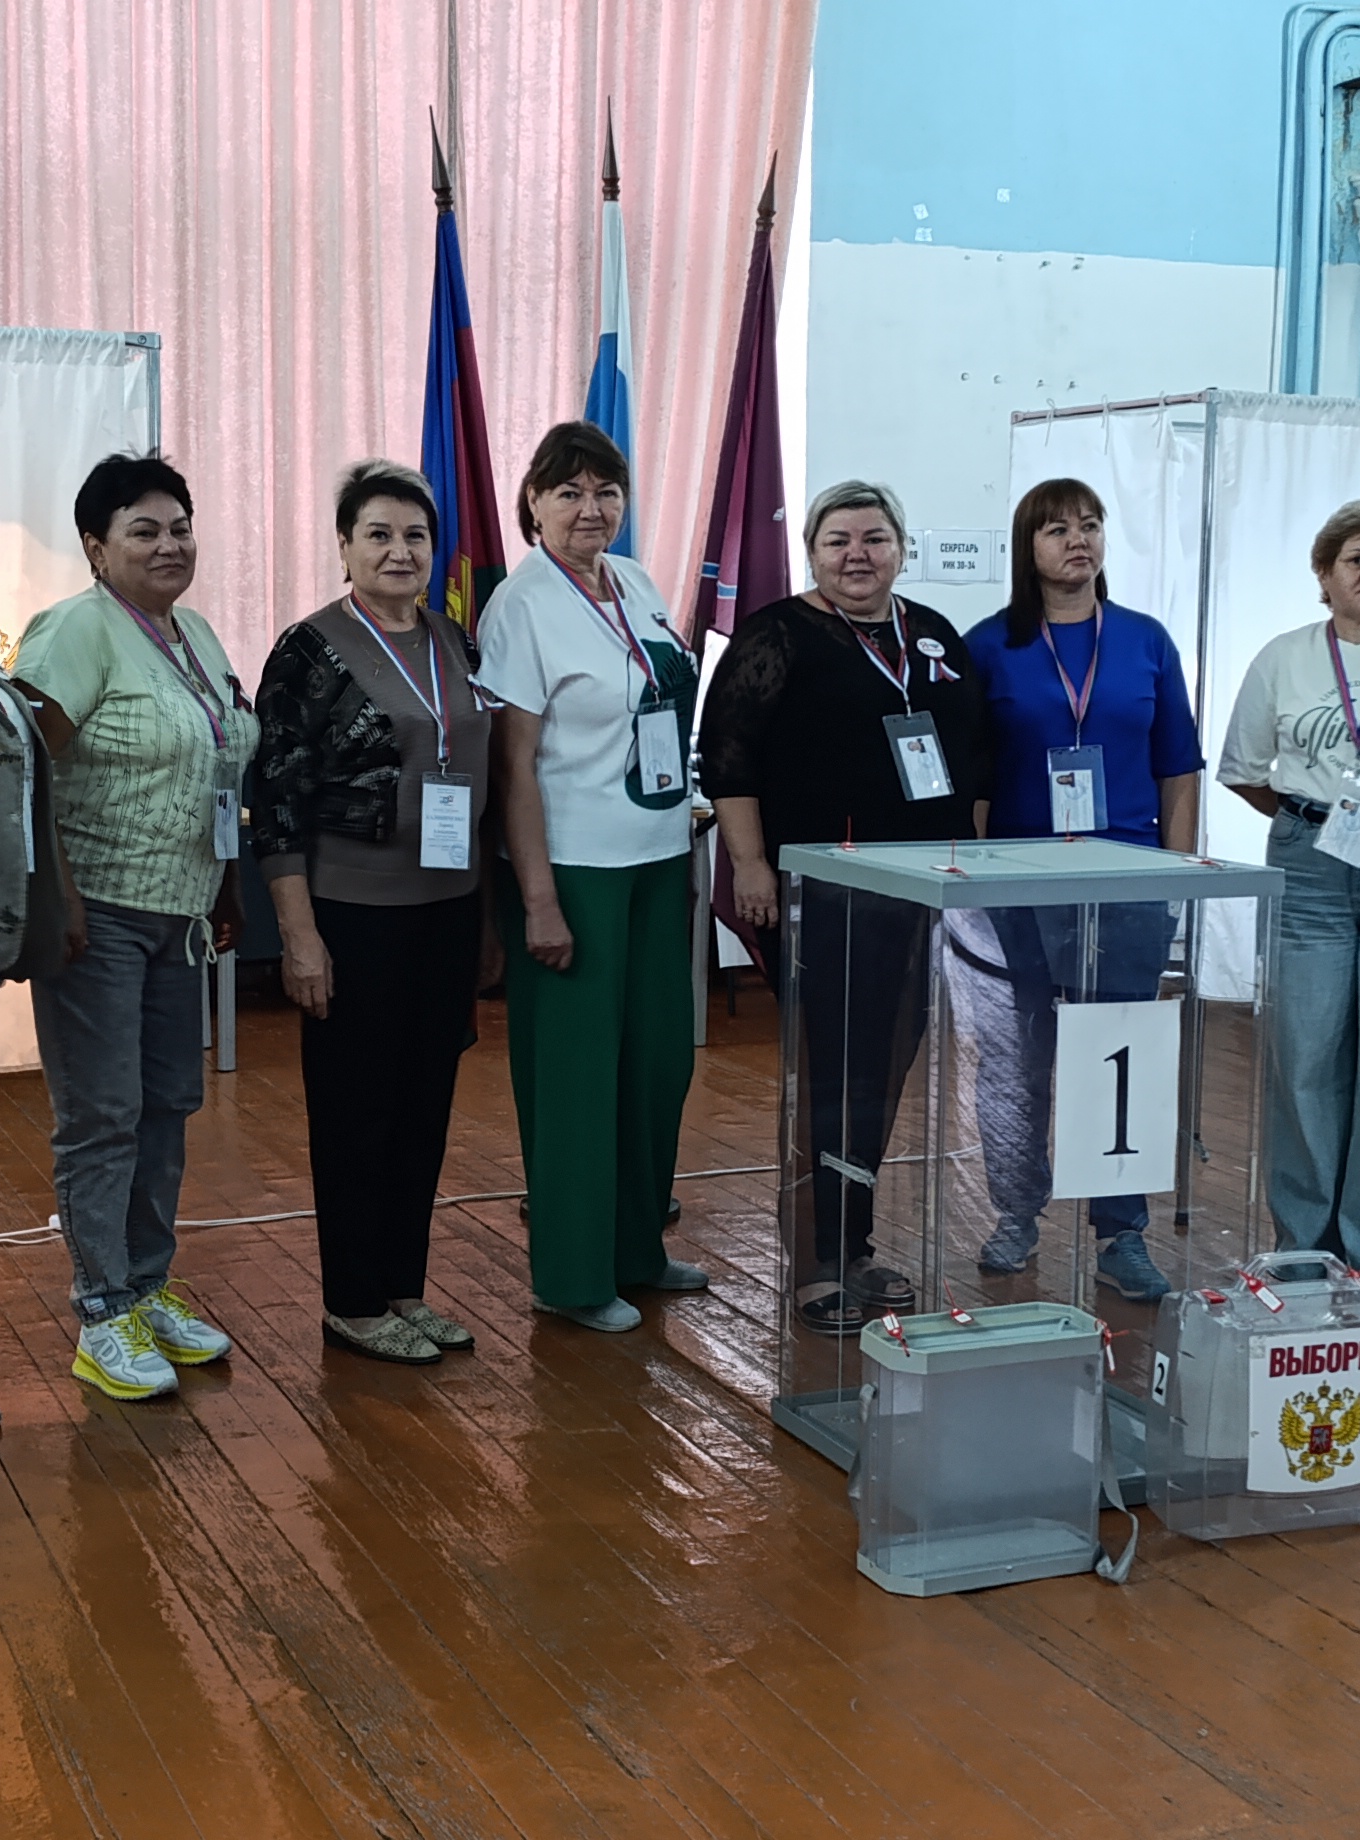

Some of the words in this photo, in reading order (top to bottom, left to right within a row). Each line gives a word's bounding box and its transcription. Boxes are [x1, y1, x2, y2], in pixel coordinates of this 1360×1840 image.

[940, 543, 979, 553] СЕКРЕТАРЬ
[942, 561, 956, 569] УИК
[1103, 1045, 1139, 1156] 1
[1154, 1362, 1165, 1396] 2
